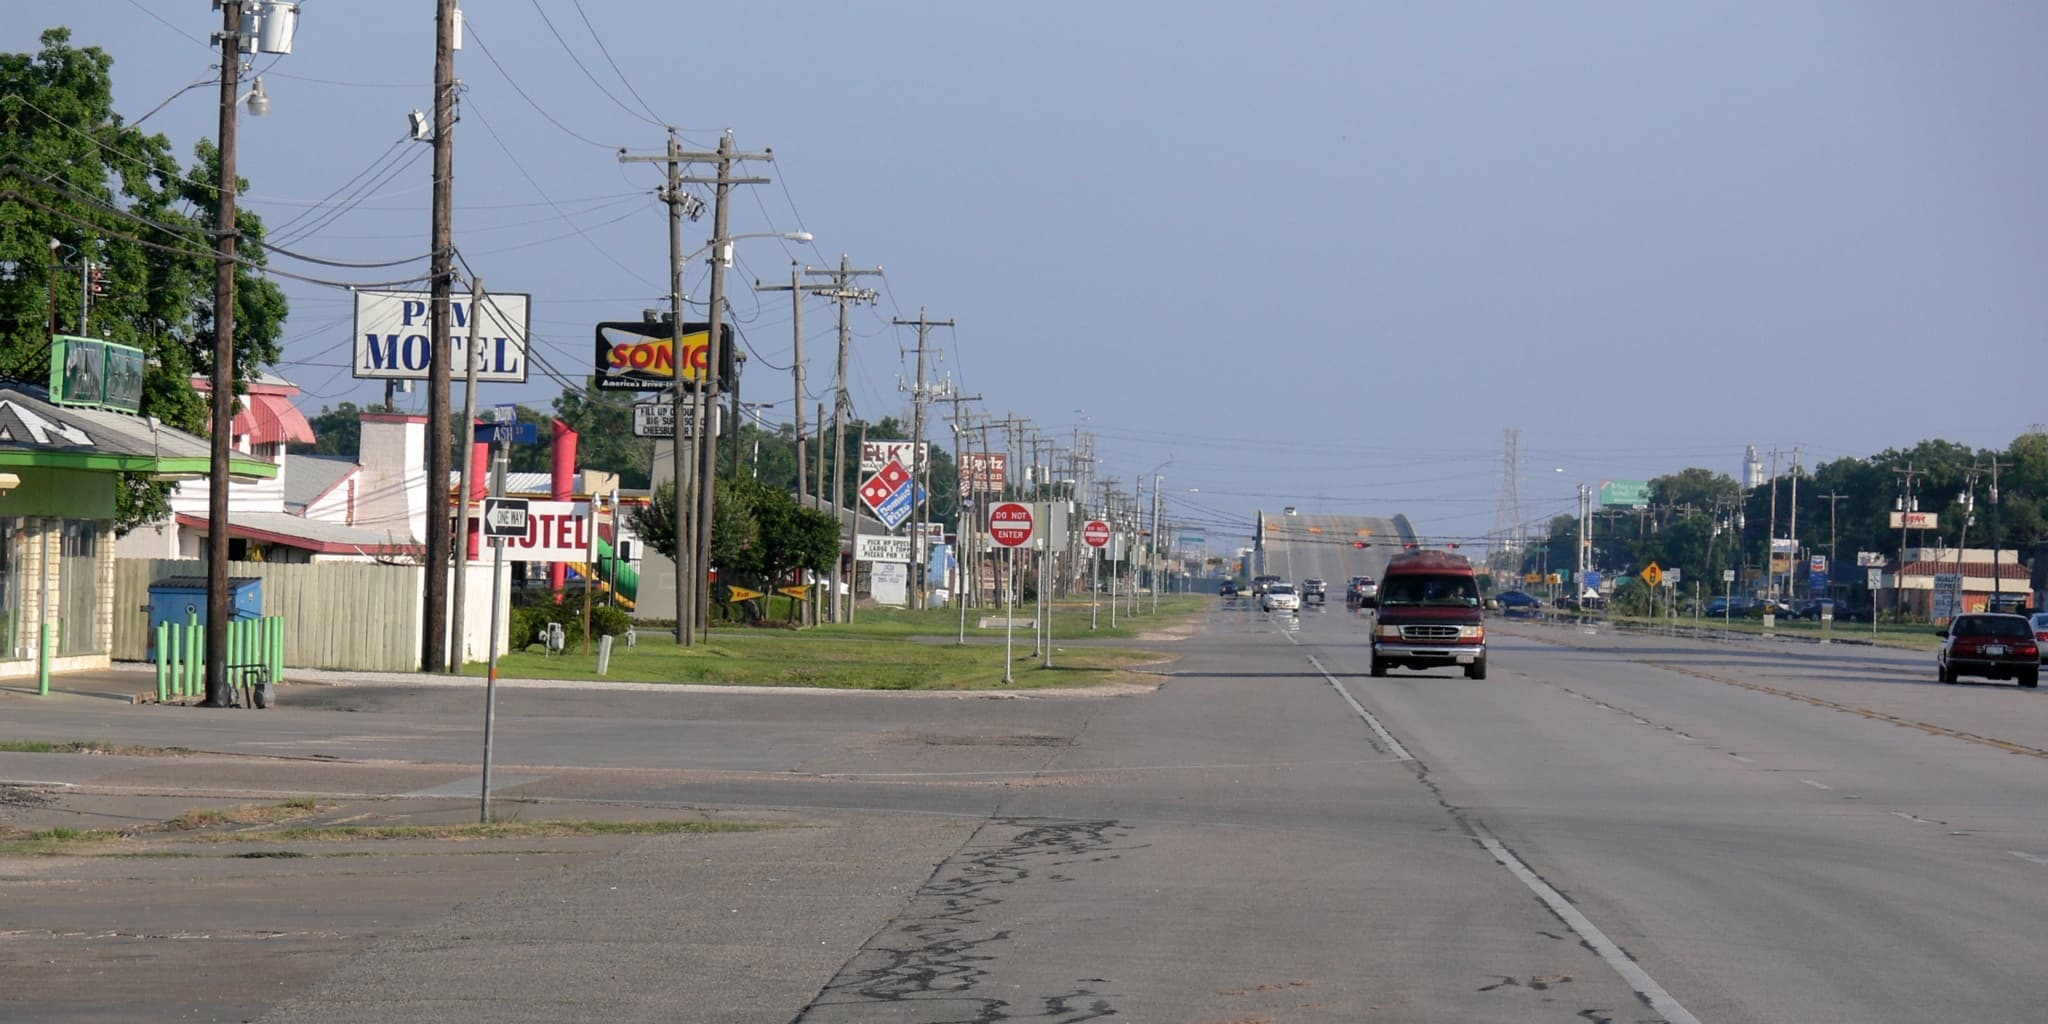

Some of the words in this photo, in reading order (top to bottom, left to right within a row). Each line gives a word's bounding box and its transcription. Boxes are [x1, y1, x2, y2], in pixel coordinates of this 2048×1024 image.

[401, 300, 473, 329] PM
[610, 343, 711, 369] SONIC
[646, 417, 659, 425] BIG
[493, 426, 513, 441] ASH
[497, 510, 510, 525] ONE
[511, 511, 524, 525] WAY
[886, 504, 912, 525] Pizza
[995, 511, 1007, 520] DO
[1011, 511, 1027, 520] NOT
[998, 530, 1023, 539] ENTER
